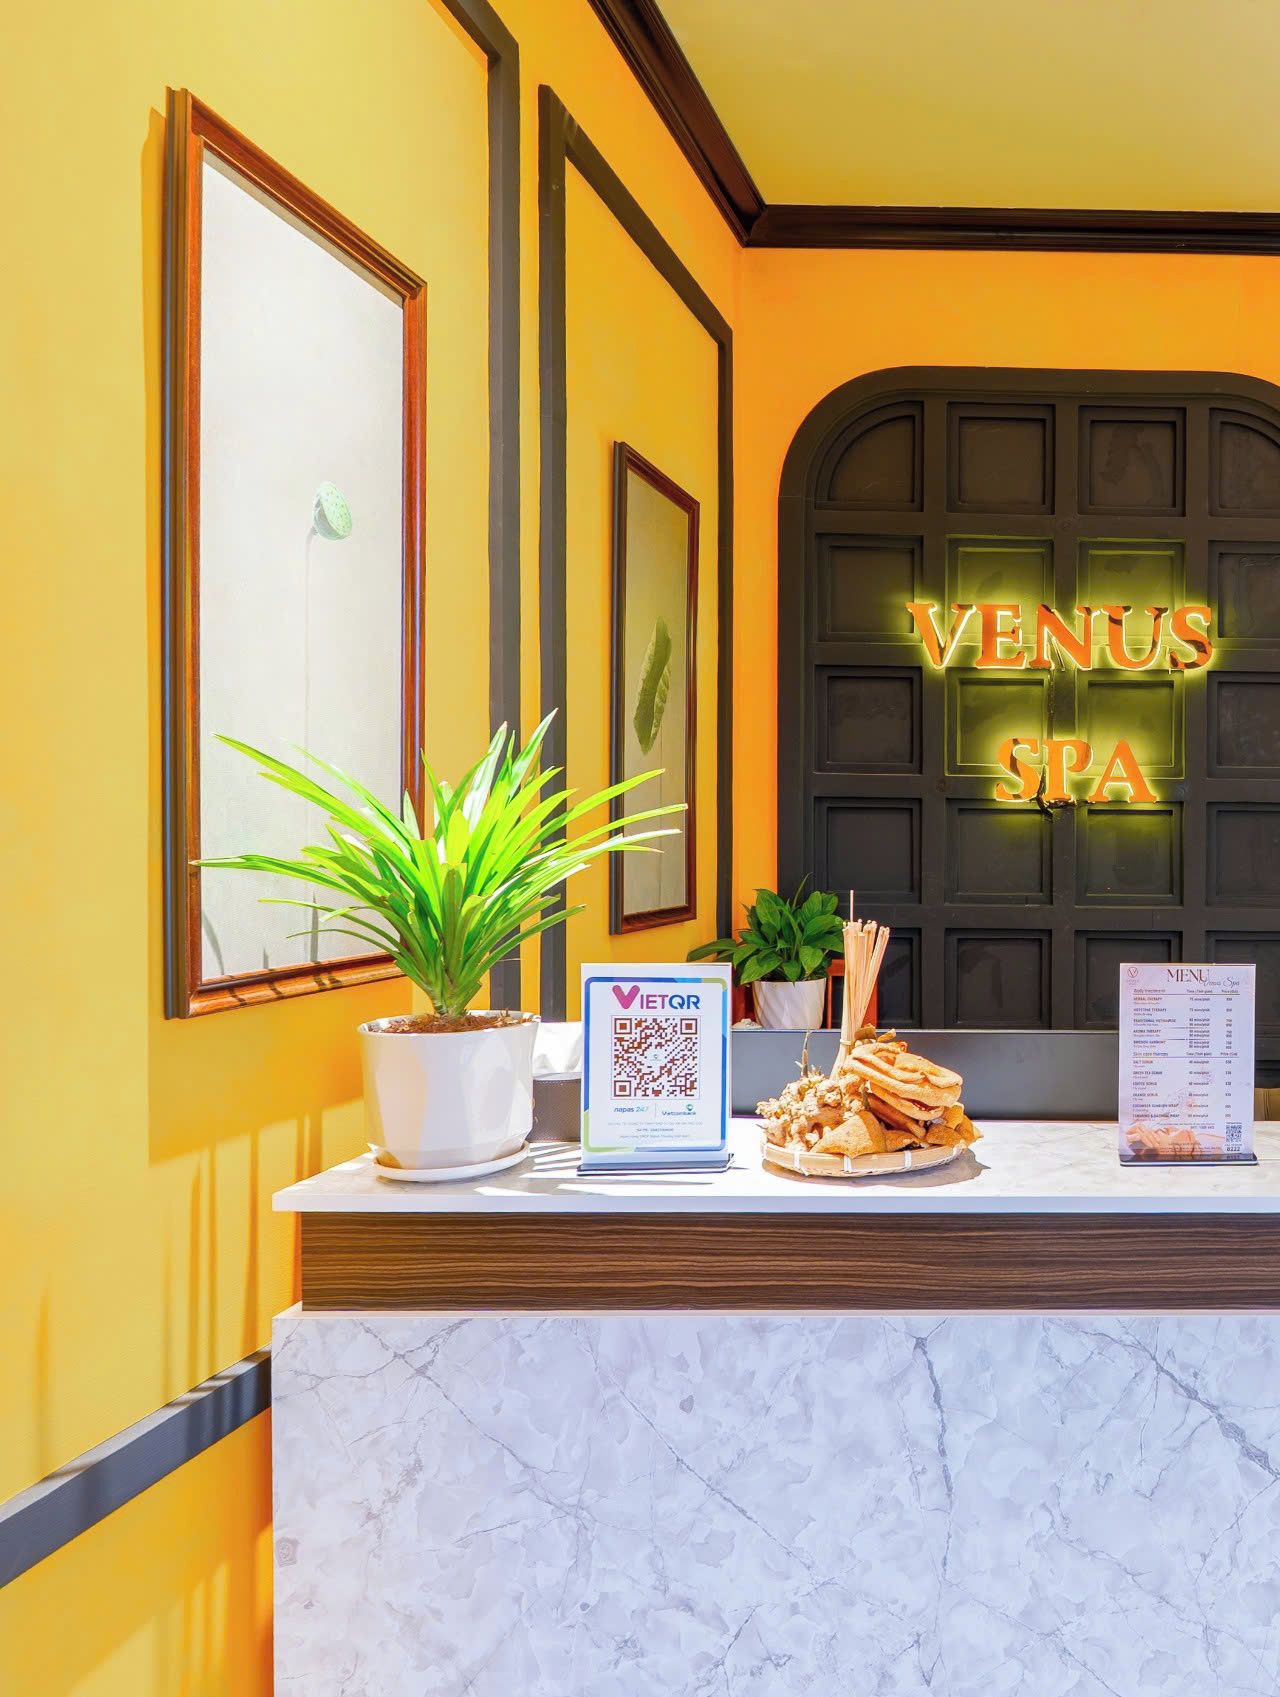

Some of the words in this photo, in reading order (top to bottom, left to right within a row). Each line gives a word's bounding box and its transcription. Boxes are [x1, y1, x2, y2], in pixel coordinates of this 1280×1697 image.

[905, 602, 1214, 672] VENUS
[995, 738, 1158, 804] SPA
[612, 984, 701, 1010] VIETQR
[1167, 968, 1210, 983] MENU
